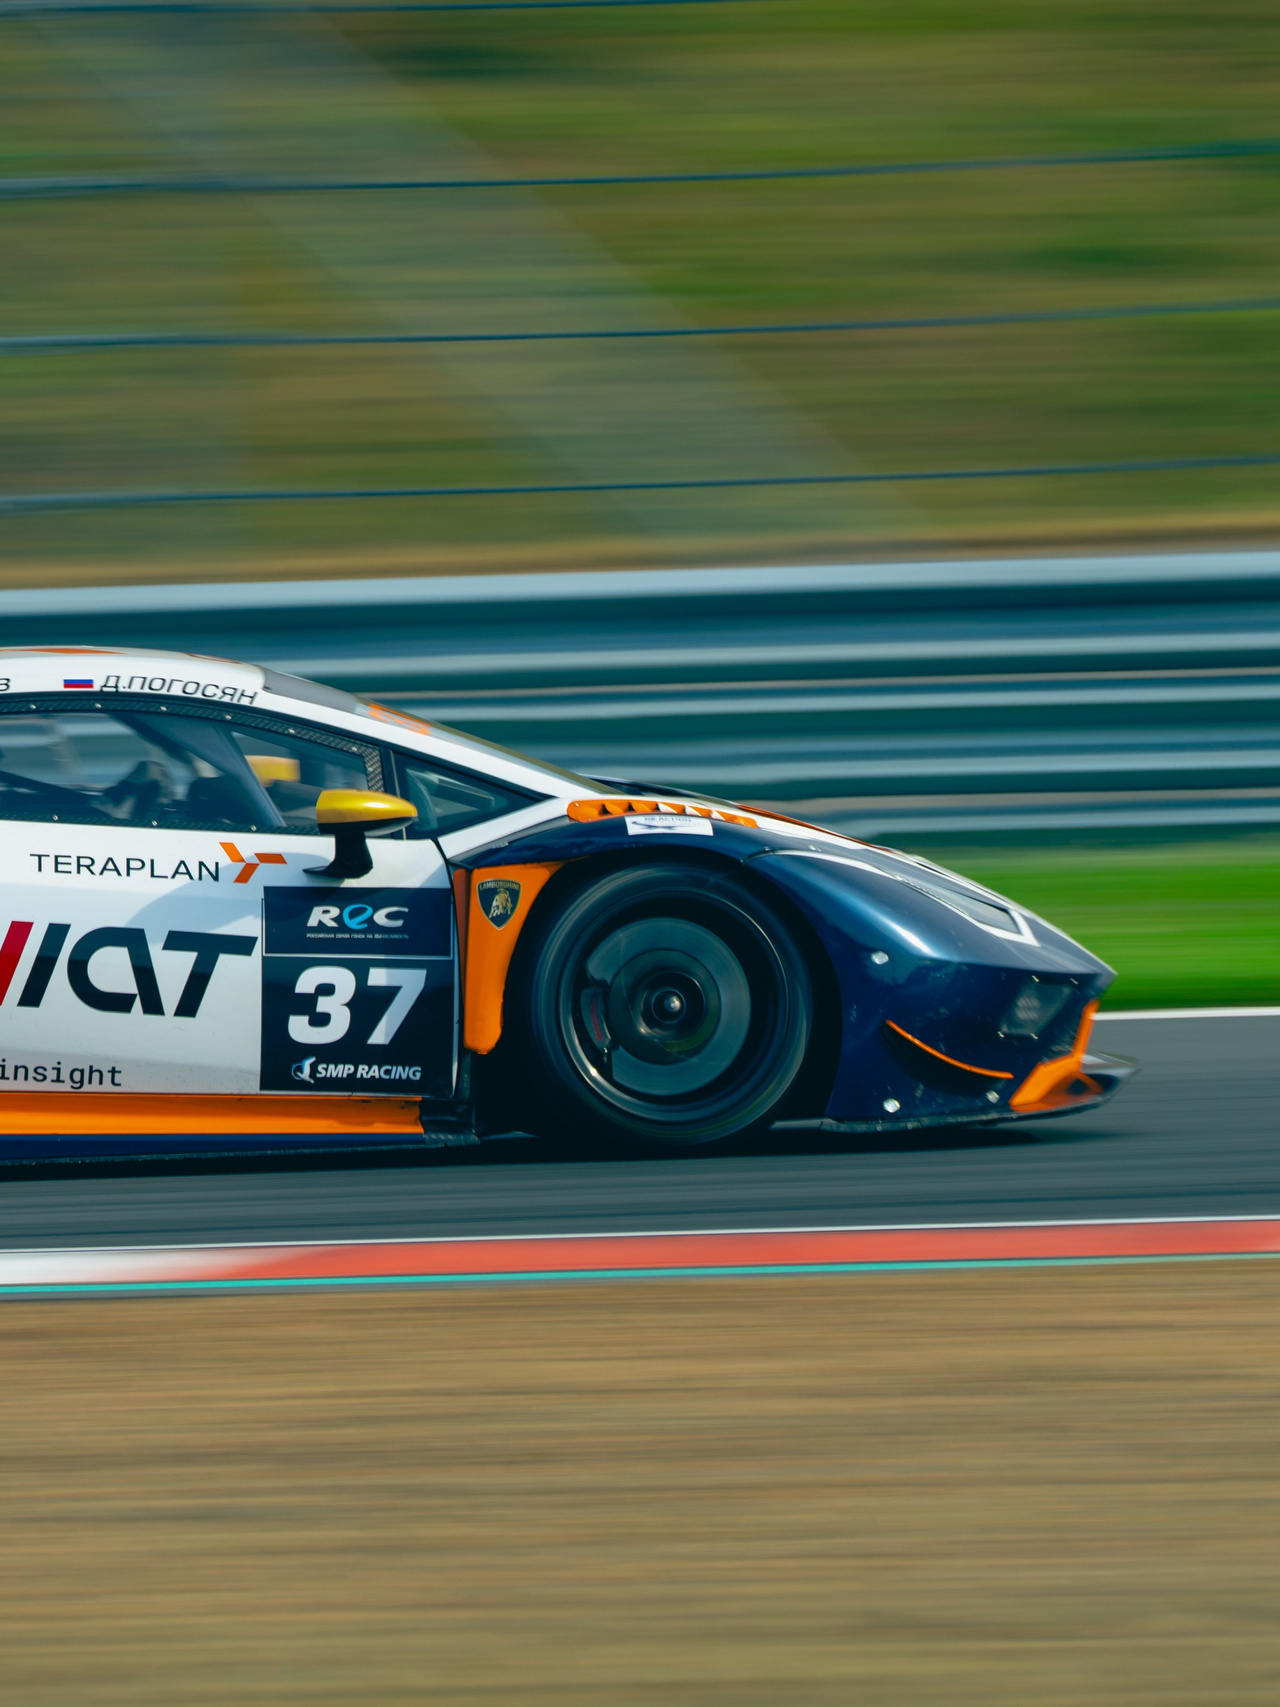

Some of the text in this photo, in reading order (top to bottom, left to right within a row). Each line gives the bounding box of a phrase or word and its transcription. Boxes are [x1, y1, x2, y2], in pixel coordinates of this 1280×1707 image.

[100, 675, 258, 705] Д.ПОГОСЯН
[29, 853, 220, 882] TERAPLAN
[288, 965, 427, 1045] 37
[316, 1063, 422, 1080] SMP RACING
